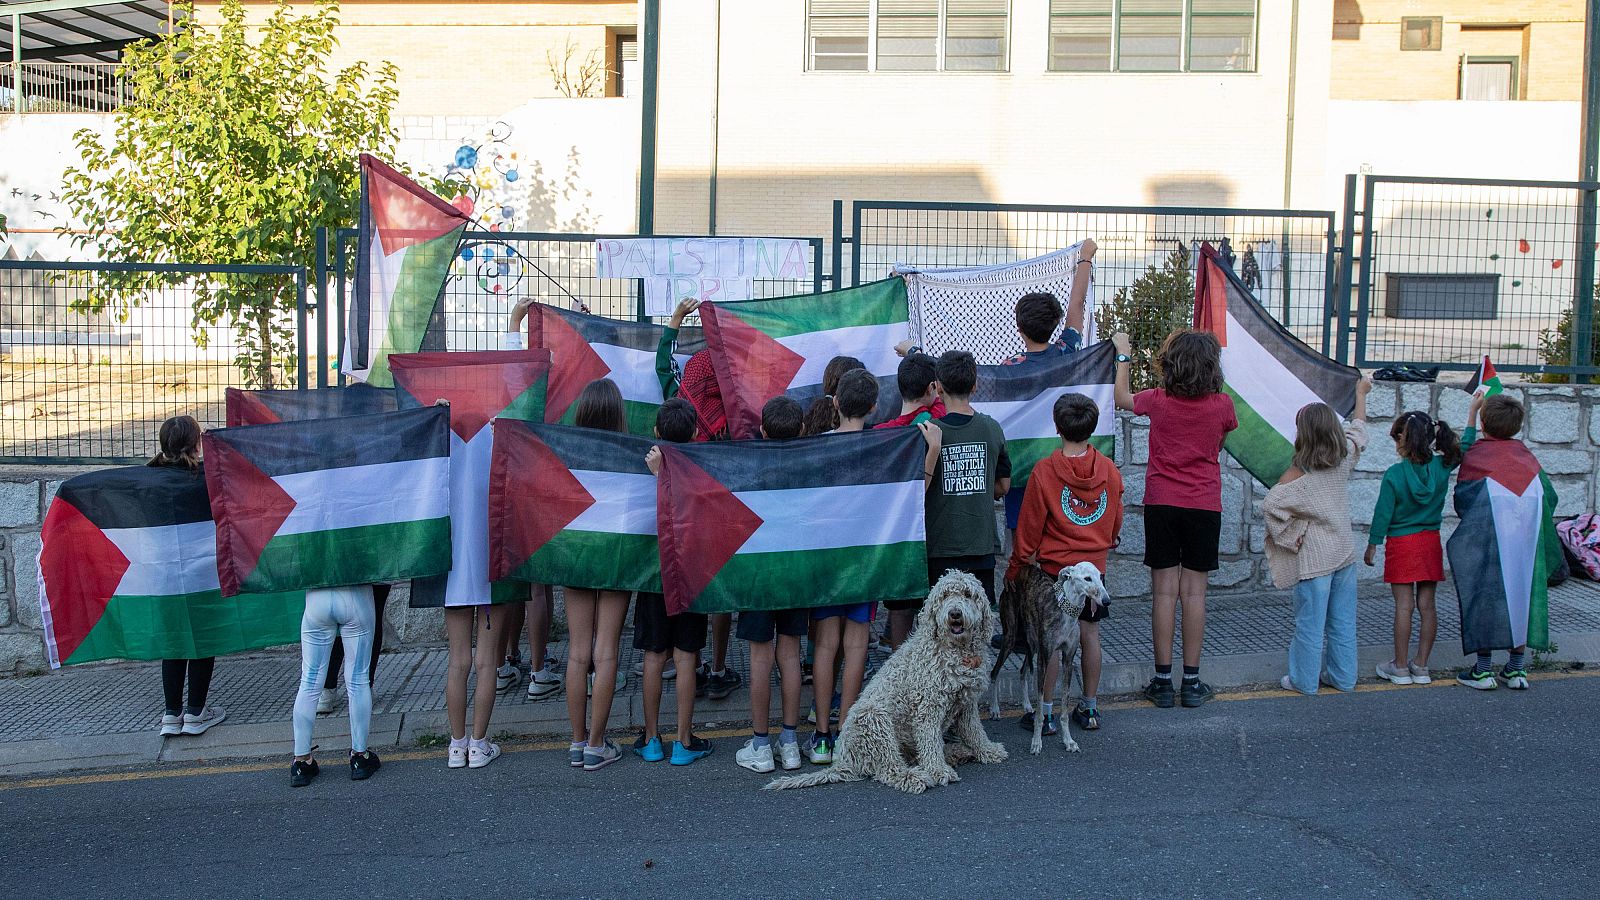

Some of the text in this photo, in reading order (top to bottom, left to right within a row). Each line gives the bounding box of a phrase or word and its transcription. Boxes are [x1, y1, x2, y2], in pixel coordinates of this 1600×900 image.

[948, 446, 961, 454] ERES
[943, 459, 985, 472] INJUSTICIA
[965, 469, 977, 477] LADO
[944, 476, 986, 492] OPRESOR
